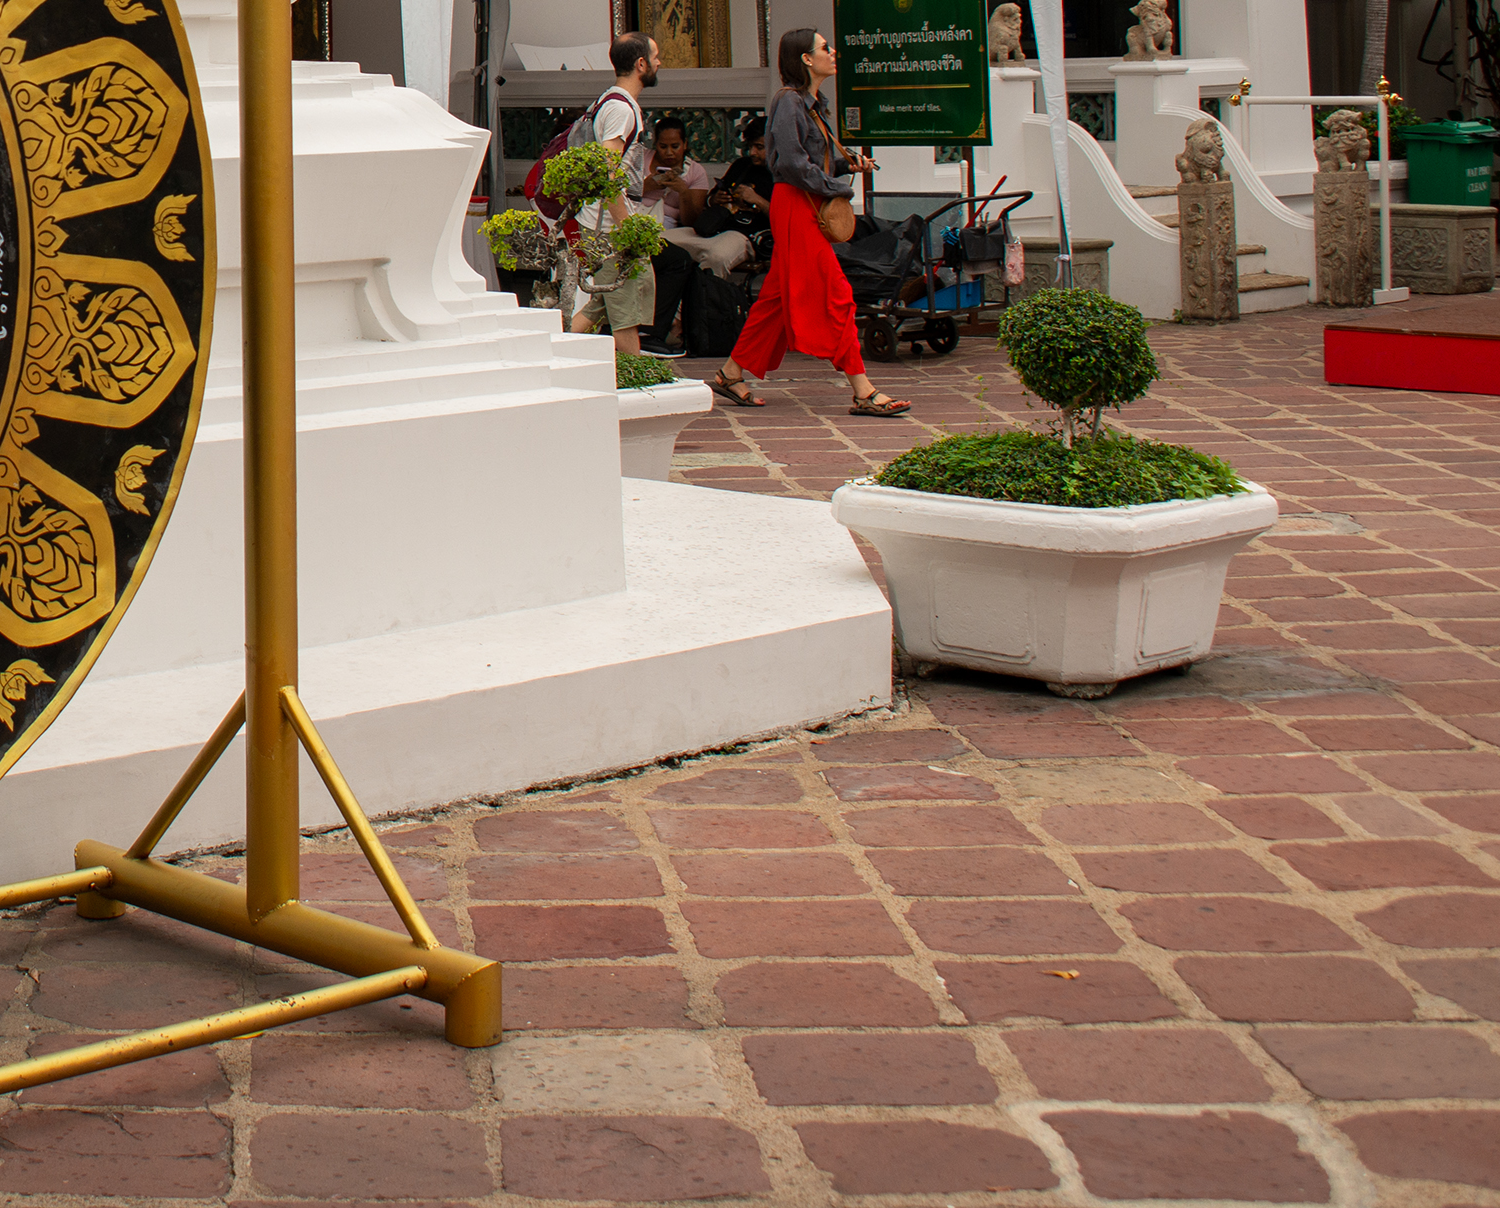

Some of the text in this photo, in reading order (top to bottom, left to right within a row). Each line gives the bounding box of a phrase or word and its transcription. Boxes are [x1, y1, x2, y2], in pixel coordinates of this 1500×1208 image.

[844, 21, 973, 49] ขอเชิญทำบุญกระเบื้องหลังคา
[854, 53, 963, 74] เสริมความมั่นคงของชีวิต
[878, 104, 895, 112] Make
[896, 103, 912, 112] merit
[913, 102, 926, 112] roof
